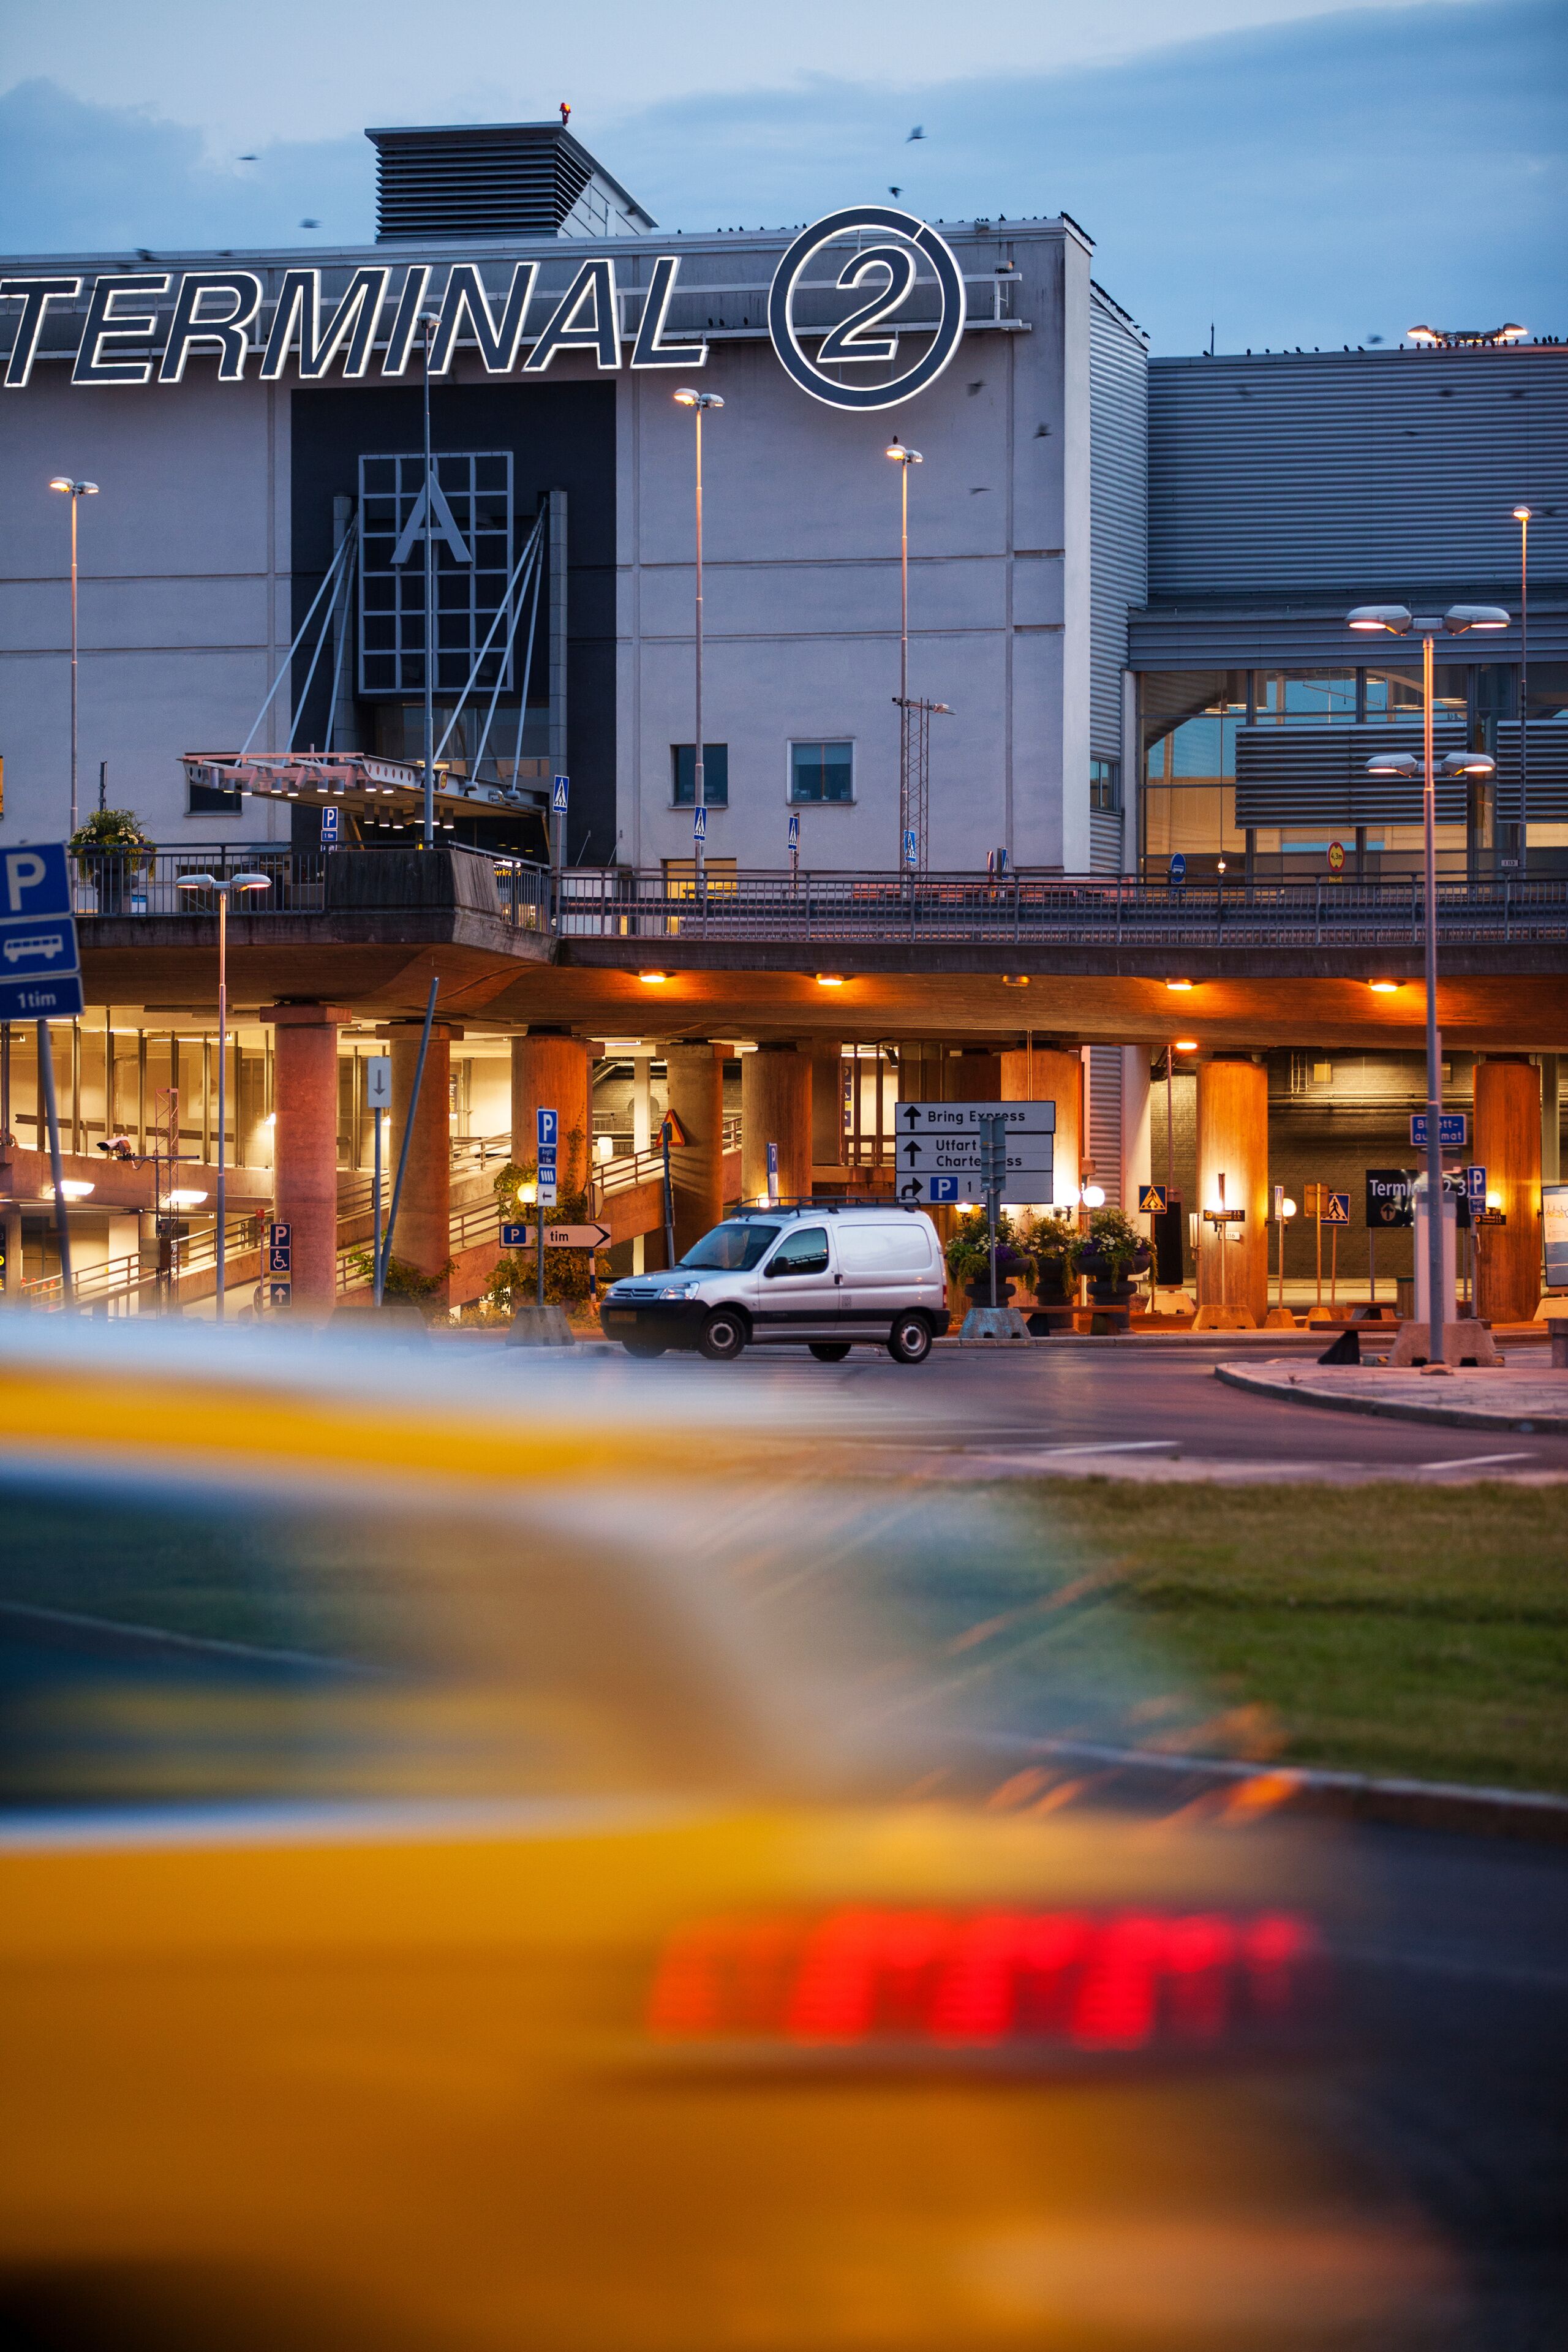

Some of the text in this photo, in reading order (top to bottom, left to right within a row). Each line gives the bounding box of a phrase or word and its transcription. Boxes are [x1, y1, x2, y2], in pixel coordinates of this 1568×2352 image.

[0, 245, 917, 388] TERMINAL 2
[390, 471, 473, 564] A
[326, 809, 335, 827] P
[6, 852, 47, 911] P
[928, 1110, 963, 1125] Bring
[1417, 1119, 1459, 1129] Bett-
[543, 1114, 553, 1142] P
[1415, 1131, 1462, 1141] aumat
[936, 1139, 977, 1152] Utfart
[771, 1147, 776, 1170] P
[936, 1155, 1022, 1167] Chartess
[938, 1178, 971, 1199] P 1
[1370, 1178, 1429, 1196] Termin
[1473, 1170, 1482, 1194] P
[275, 1226, 287, 1245] P
[511, 1229, 568, 1242] P tim
